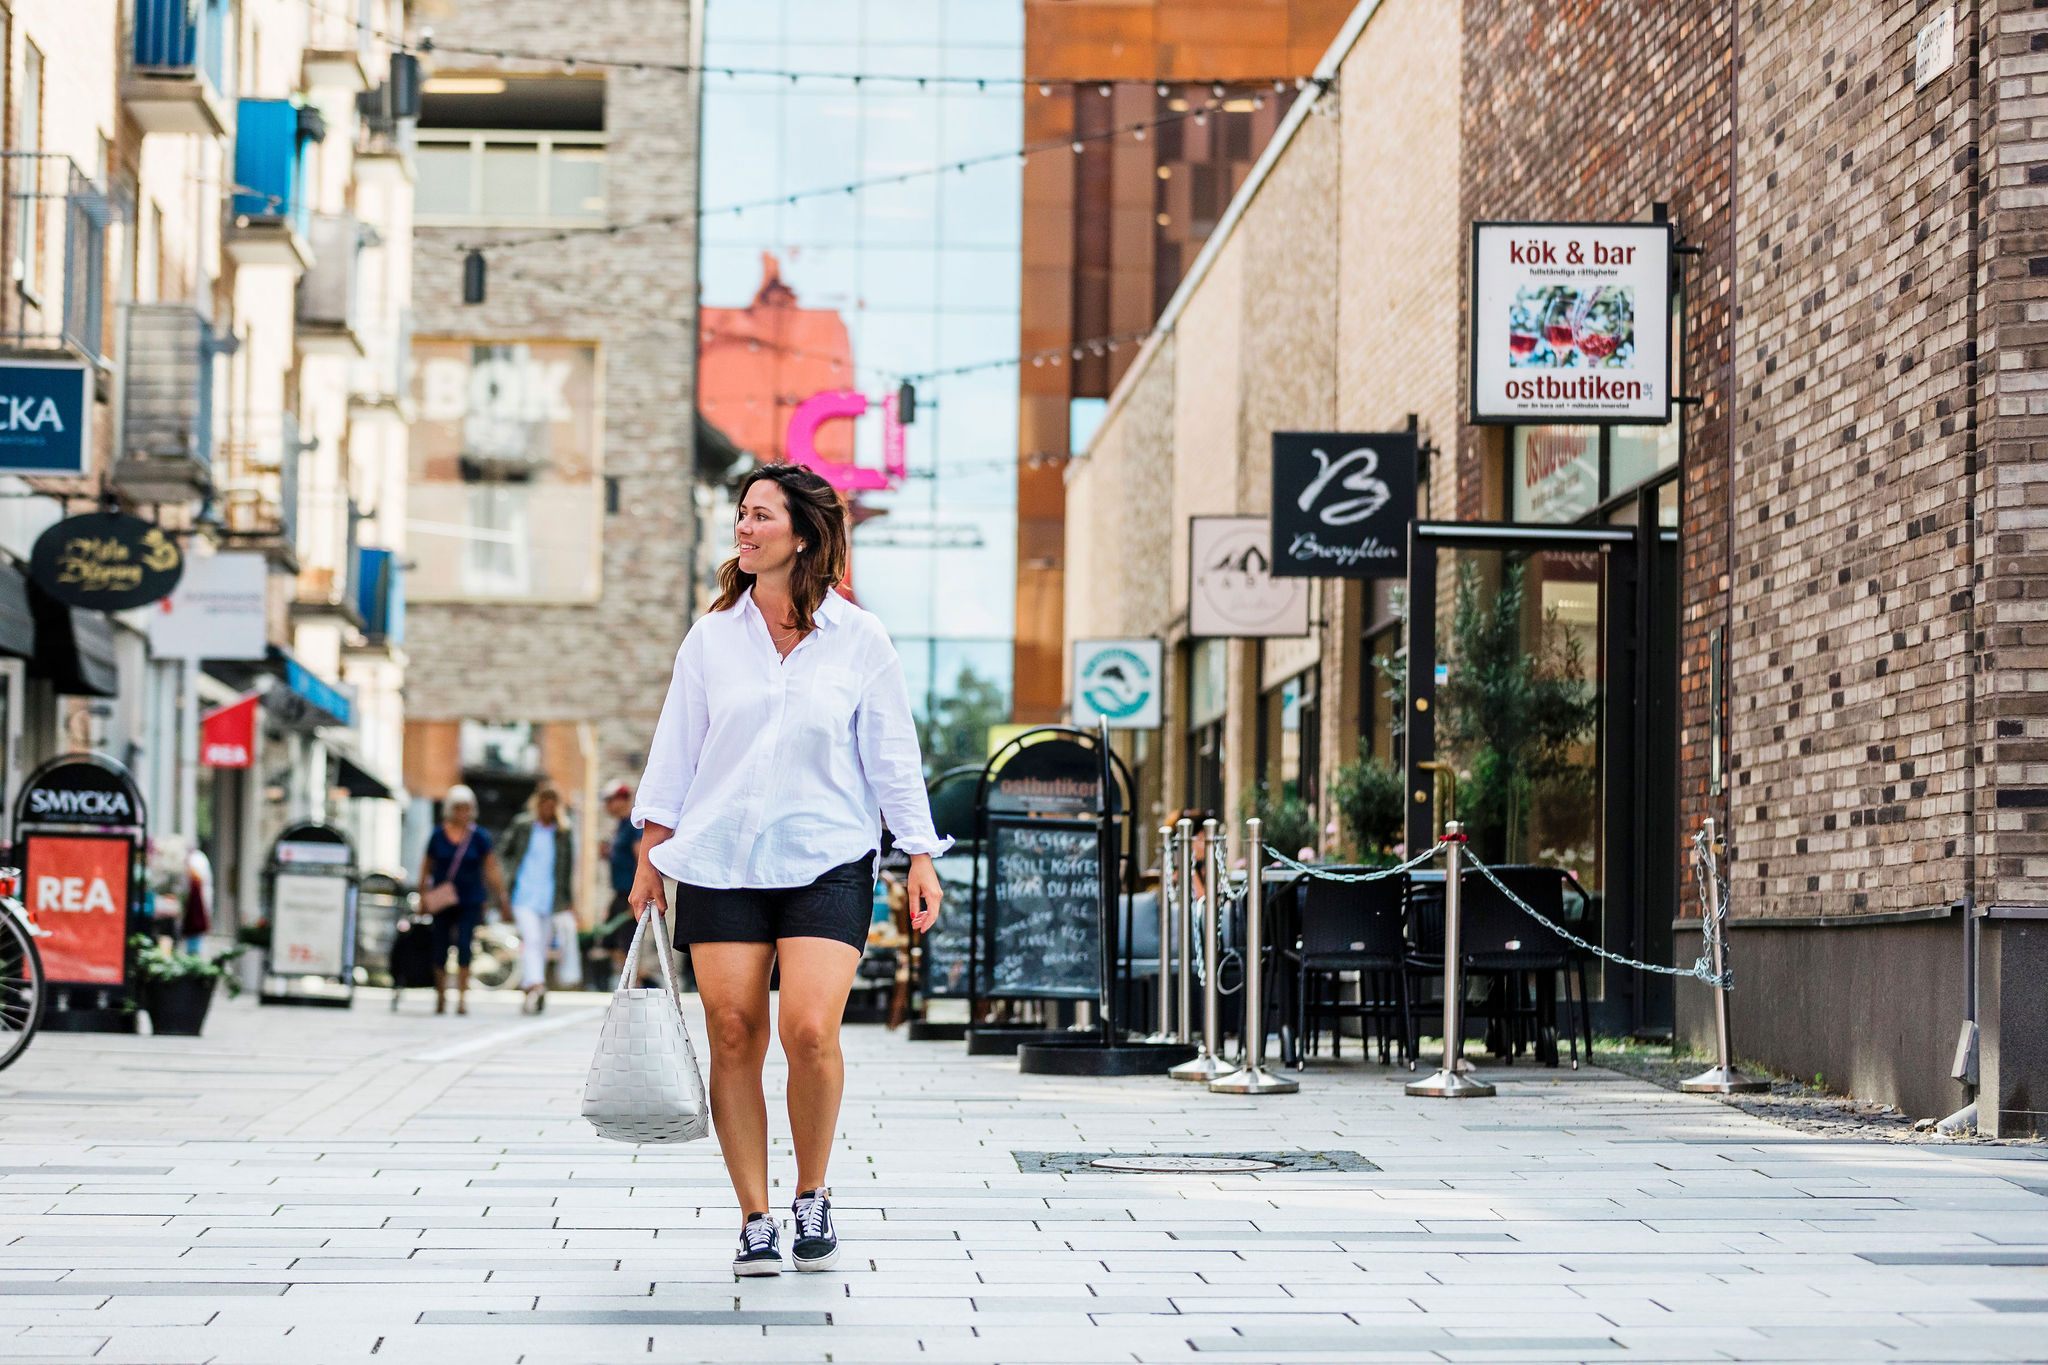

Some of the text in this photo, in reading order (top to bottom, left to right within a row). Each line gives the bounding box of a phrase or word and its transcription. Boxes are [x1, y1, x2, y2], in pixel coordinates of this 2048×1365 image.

[1510, 239, 1637, 265] kök & bar
[1505, 375, 1641, 400] ostbutiken
[206, 744, 248, 765] REA
[30, 788, 130, 816] SMYCKA
[37, 875, 116, 915] REA
